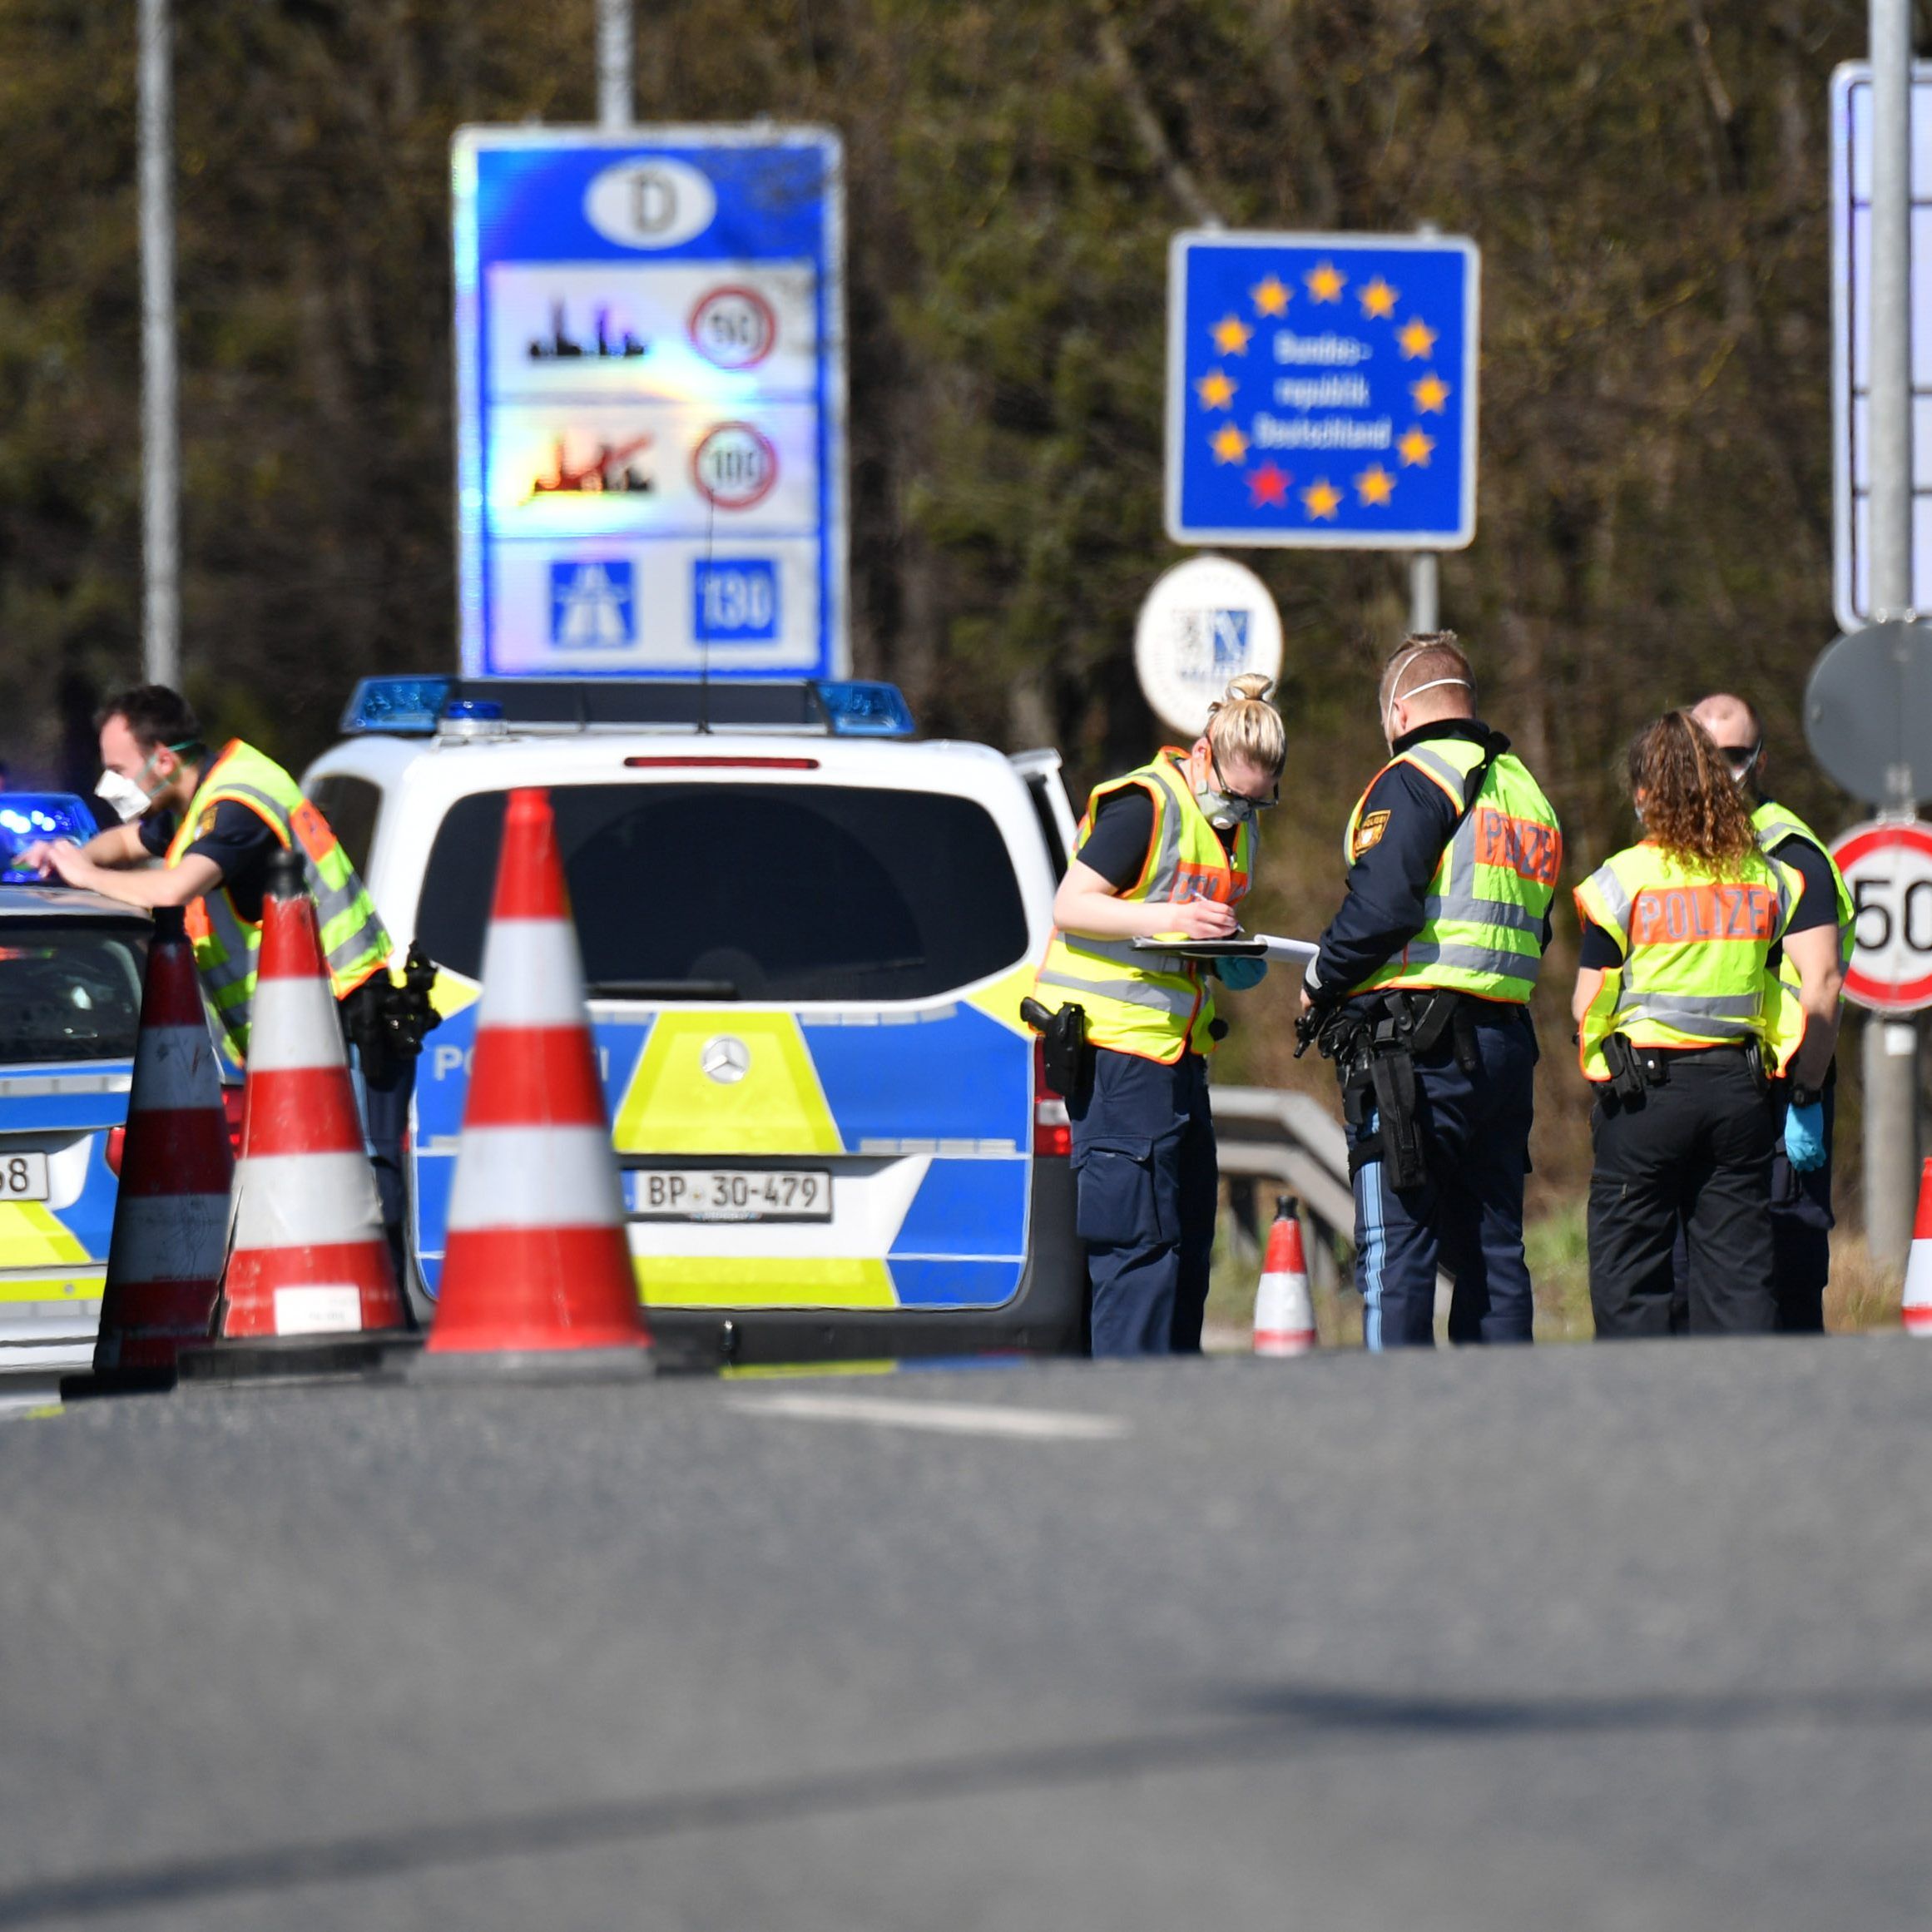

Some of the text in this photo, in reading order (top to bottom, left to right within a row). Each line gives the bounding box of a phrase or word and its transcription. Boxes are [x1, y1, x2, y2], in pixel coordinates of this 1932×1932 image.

[630, 169, 677, 233] D
[1274, 373, 1371, 413] republik
[1253, 411, 1393, 450] Deutschland
[703, 571, 772, 630] 130
[1855, 879, 1932, 952] 50
[0, 1157, 27, 1193] 8
[649, 1176, 818, 1207] BP 30-479
